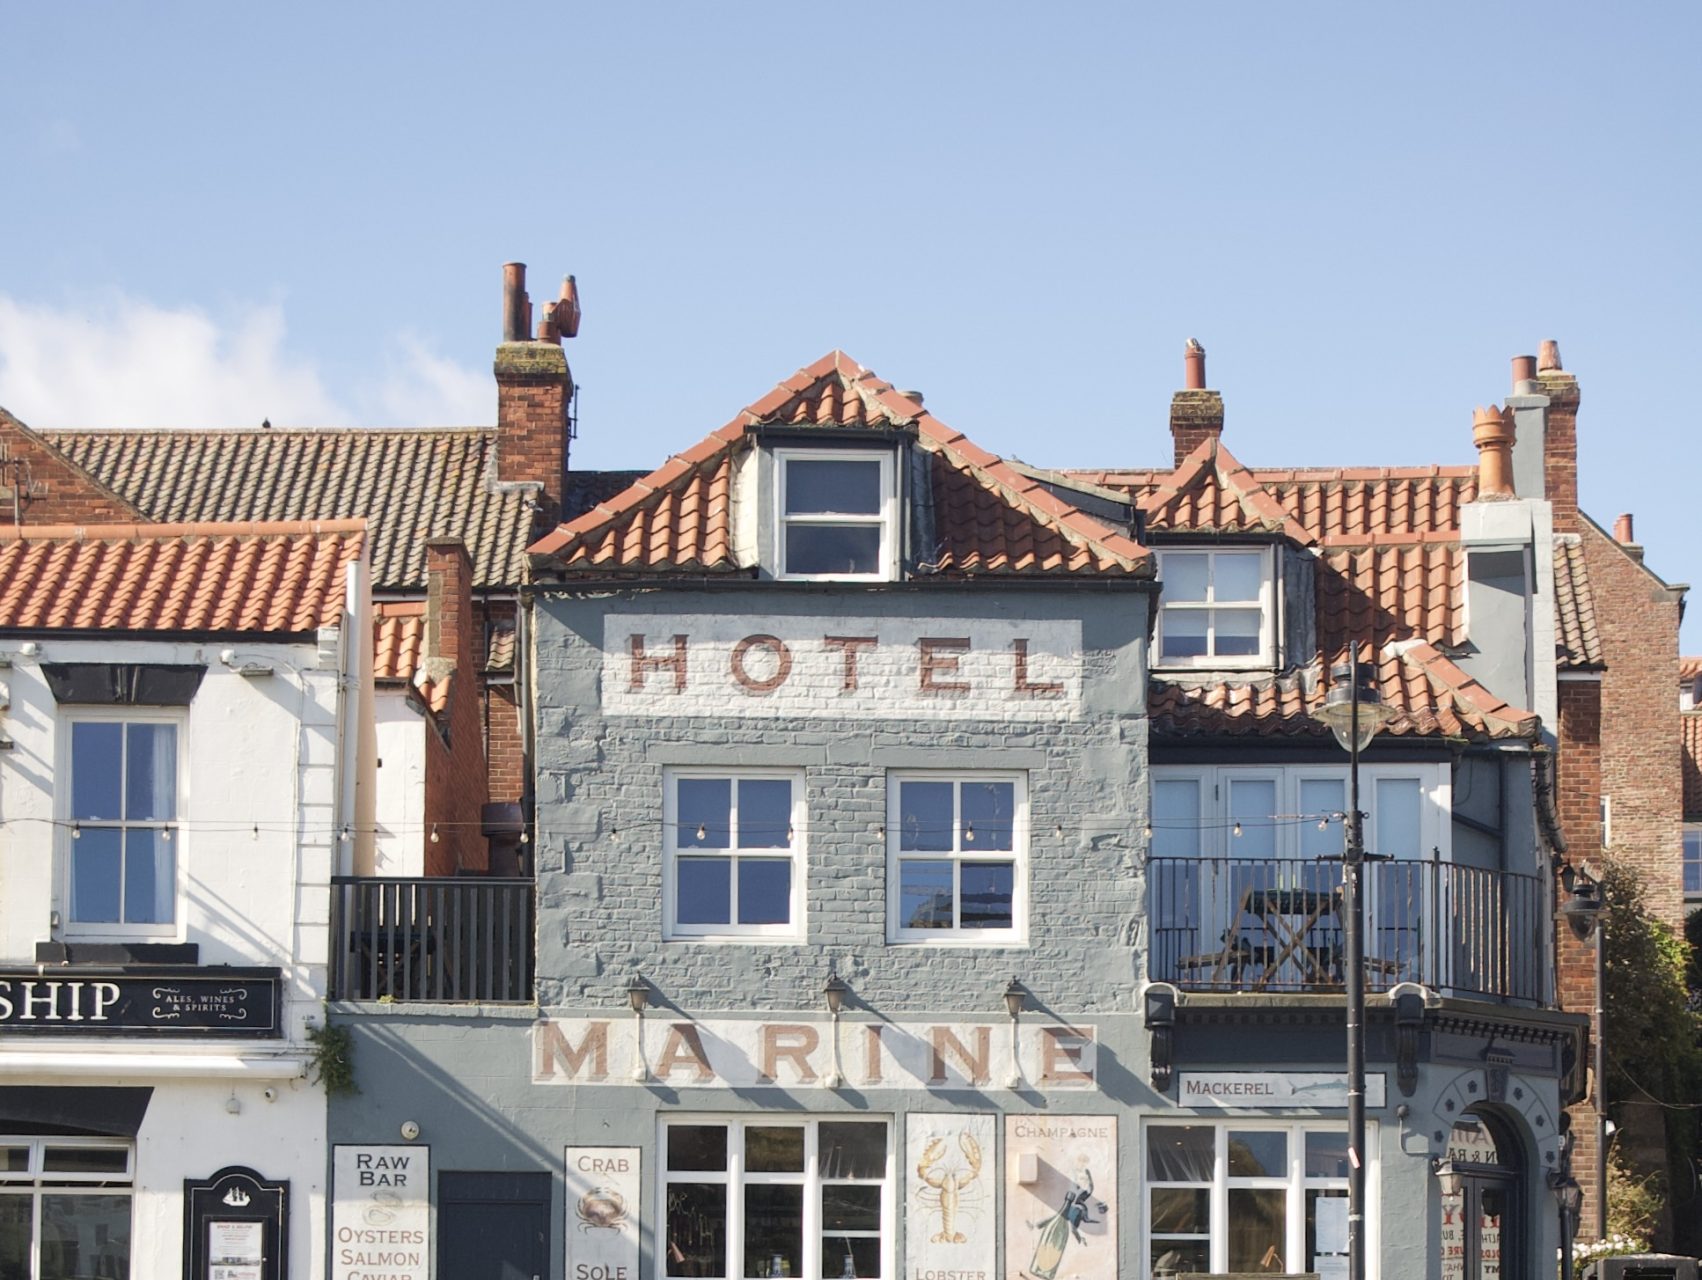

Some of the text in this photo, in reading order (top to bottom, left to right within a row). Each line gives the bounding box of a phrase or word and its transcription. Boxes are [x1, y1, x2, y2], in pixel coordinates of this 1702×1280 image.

[625, 633, 1064, 696] HOTEL
[200, 995, 235, 1004] WINES
[534, 1021, 1094, 1086] MARINE
[1186, 1080, 1274, 1095] MACKEREL
[1014, 1125, 1108, 1138] CHAMPAGNE
[356, 1153, 410, 1170] RAW
[577, 1155, 630, 1172] CRAB
[360, 1171, 407, 1187] BAR
[338, 1226, 424, 1244] OYSTERS
[341, 1249, 420, 1266] SALMON
[576, 1263, 628, 1280] SOLE
